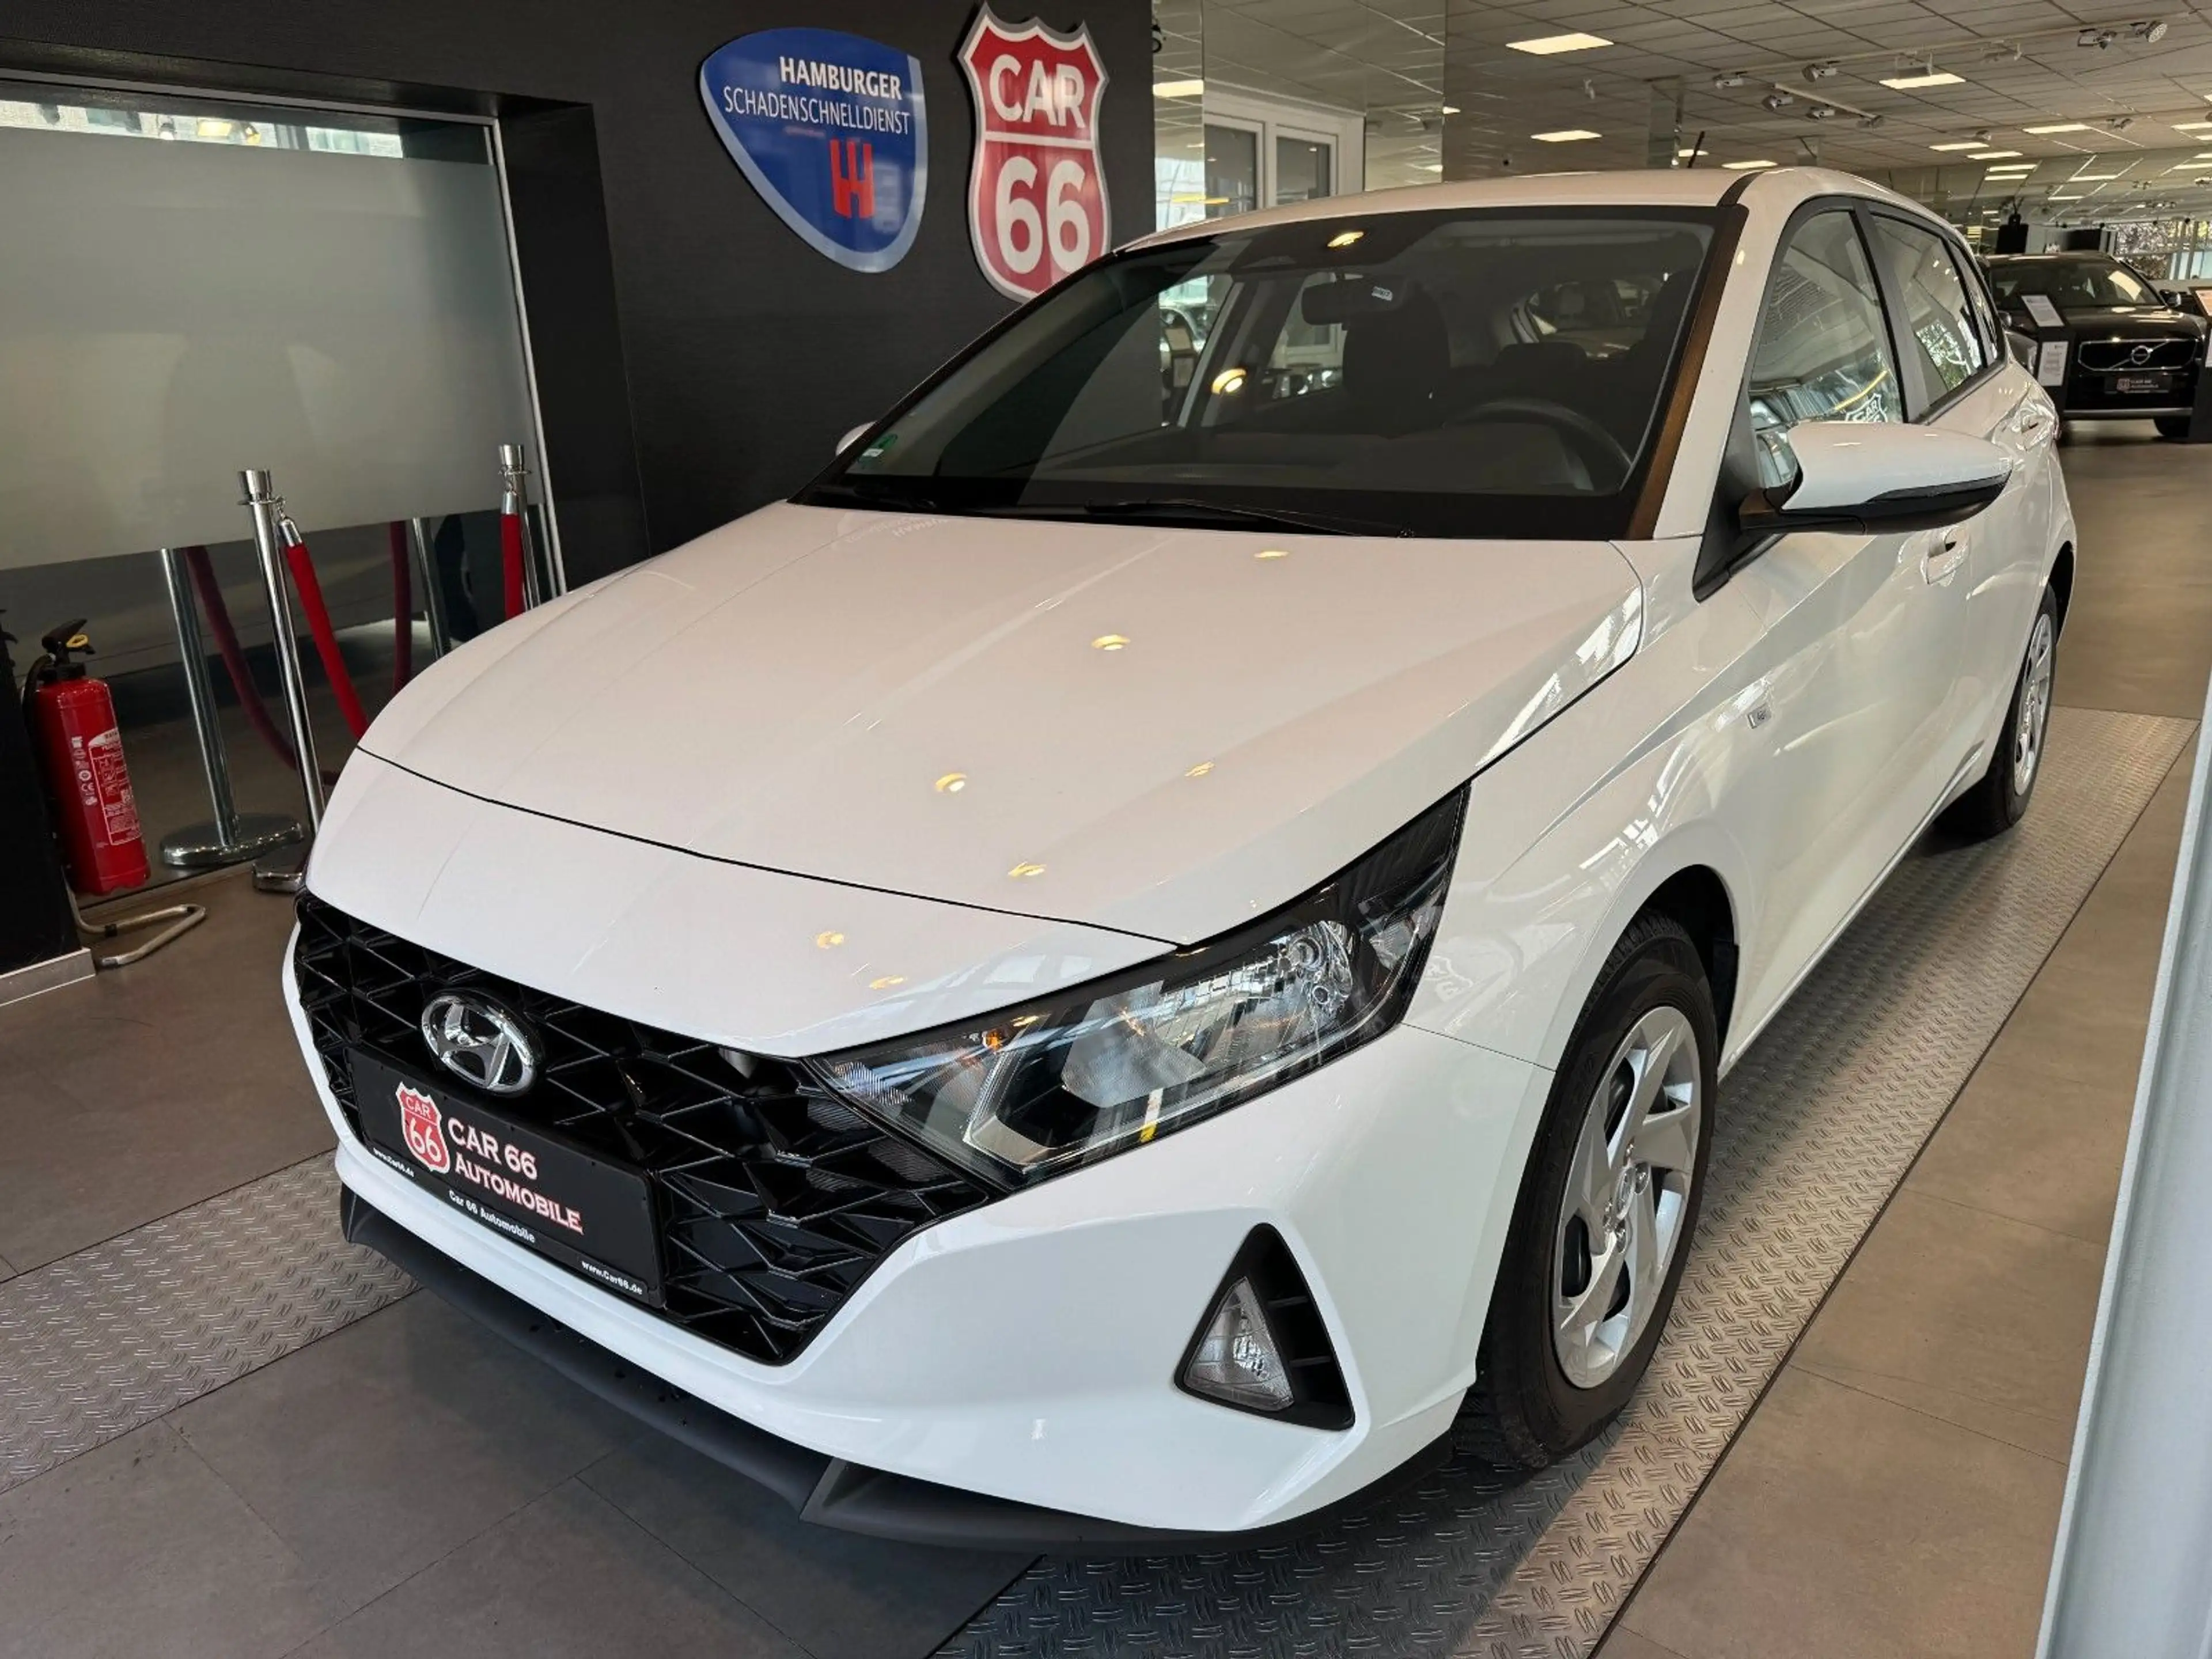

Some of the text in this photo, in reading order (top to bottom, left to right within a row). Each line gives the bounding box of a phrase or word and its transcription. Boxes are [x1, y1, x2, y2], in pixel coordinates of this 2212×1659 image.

[779, 56, 902, 100] HAMBURGER
[989, 54, 1085, 128] CAR
[723, 86, 910, 135] SCHADENSCHNELLDIENST
[995, 156, 1090, 274] 66
[406, 1096, 431, 1119] CAR
[410, 1118, 442, 1162] 66
[448, 1117, 537, 1180] CAR 66
[449, 1189, 535, 1243] Car 66 Automobile
[455, 1152, 584, 1236] AUTOMOBILE
[582, 1261, 642, 1295] www.Car66.de
